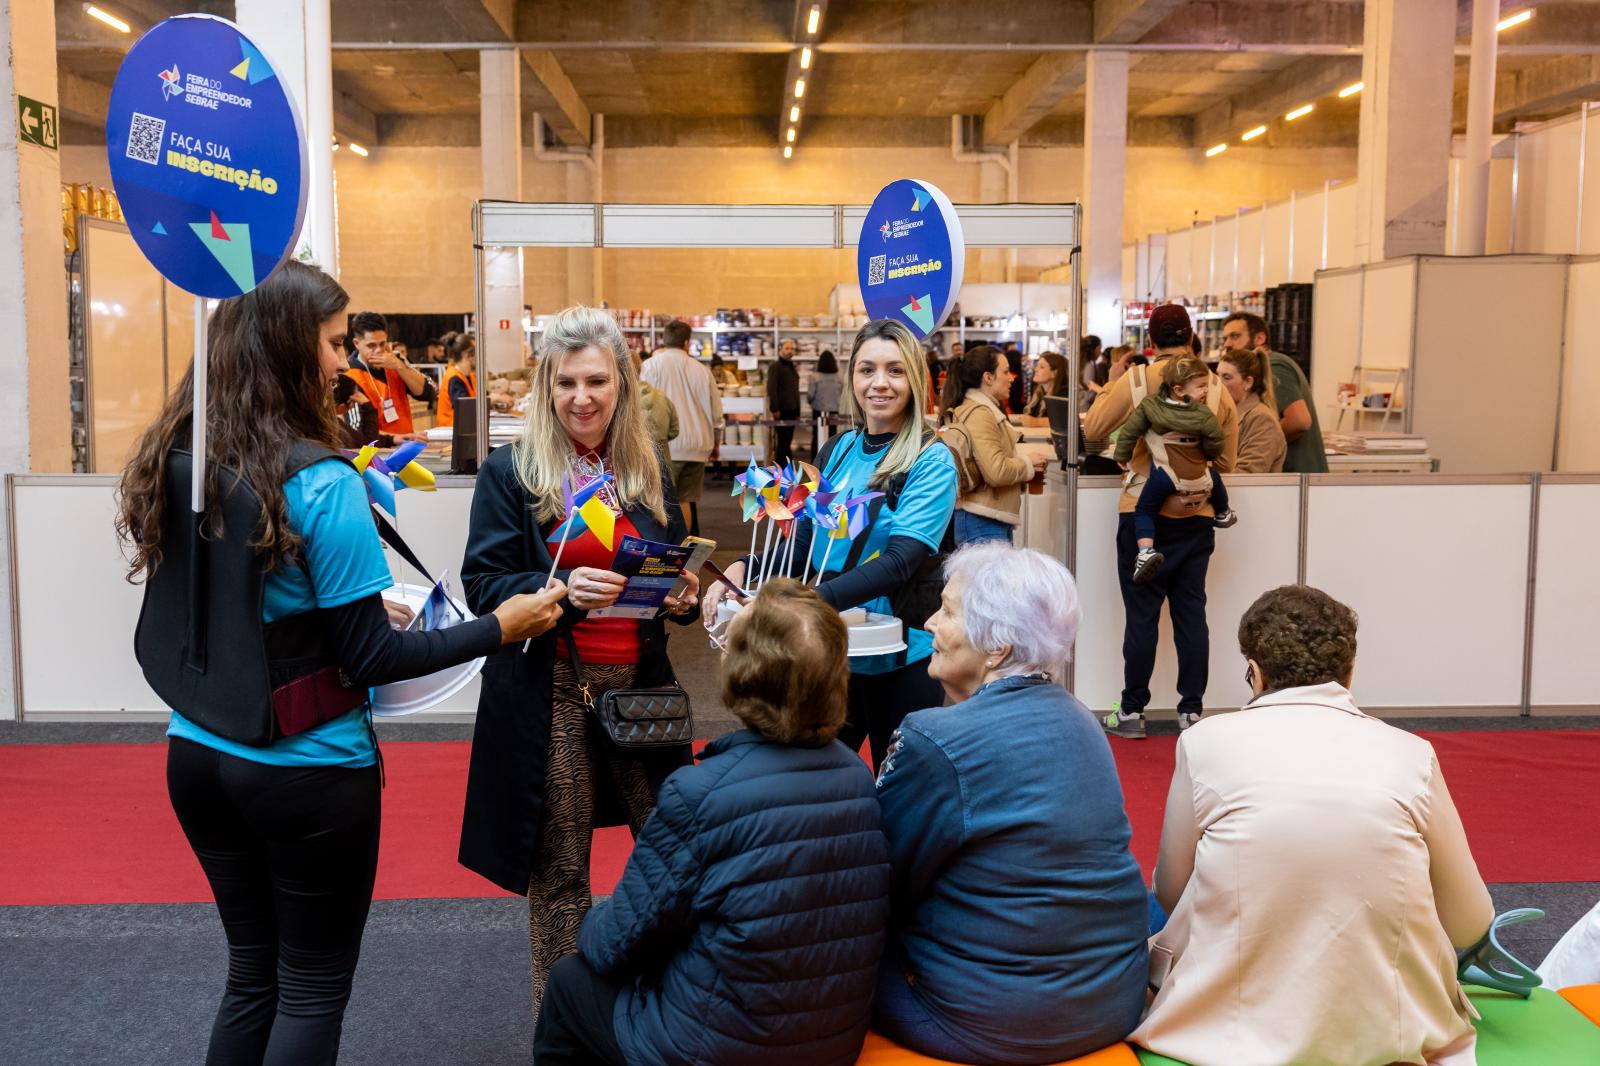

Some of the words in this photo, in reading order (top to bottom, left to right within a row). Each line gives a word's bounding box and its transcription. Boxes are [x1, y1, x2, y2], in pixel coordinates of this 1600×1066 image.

[187, 74, 209, 88] FEIRA
[210, 80, 222, 90] DO
[185, 93, 219, 110] SEBRAE
[186, 83, 252, 108] EMPREENDEDOR
[170, 132, 202, 154] FAÇA
[205, 142, 231, 161] SUA
[167, 149, 278, 194] INSCRIÇÃO
[888, 259, 942, 279] INSCRIÇÃO
[889, 256, 904, 267] FAÇA
[905, 254, 919, 264] SUA
